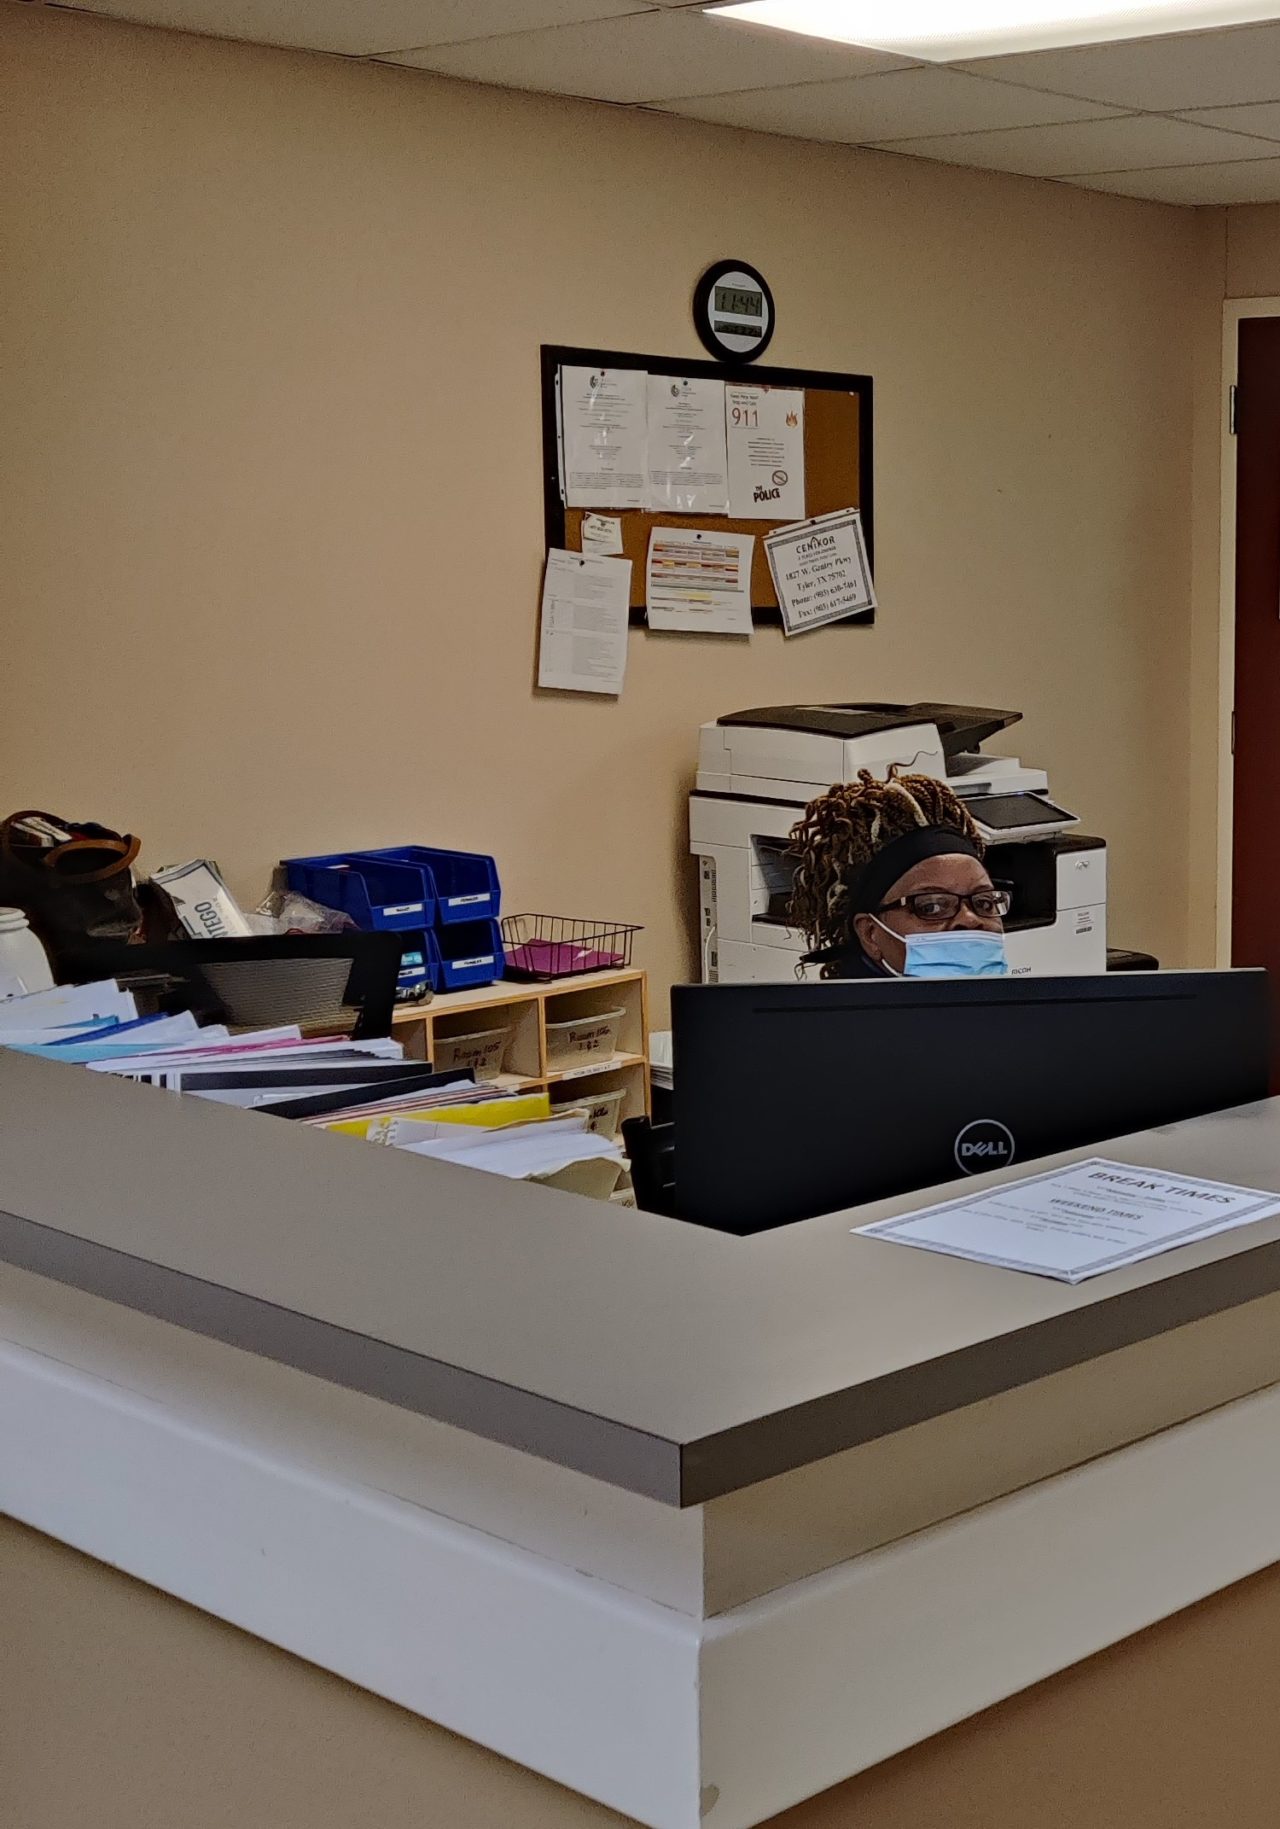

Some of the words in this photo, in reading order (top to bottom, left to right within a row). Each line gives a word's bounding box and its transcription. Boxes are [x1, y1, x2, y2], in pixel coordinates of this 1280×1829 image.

[731, 407, 759, 427] 911
[753, 487, 781, 503] POLICE
[816, 576, 828, 584] TX
[1011, 967, 1032, 975] RICOH
[569, 1031, 595, 1043] Room
[453, 1047, 482, 1063] Room
[961, 1141, 1008, 1157] DELL
[1088, 1172, 1164, 1191] BREAK
[1165, 1185, 1236, 1204] TIMES
[1050, 1198, 1107, 1214] WEEKEND
[1107, 1209, 1145, 1221] TIMES
